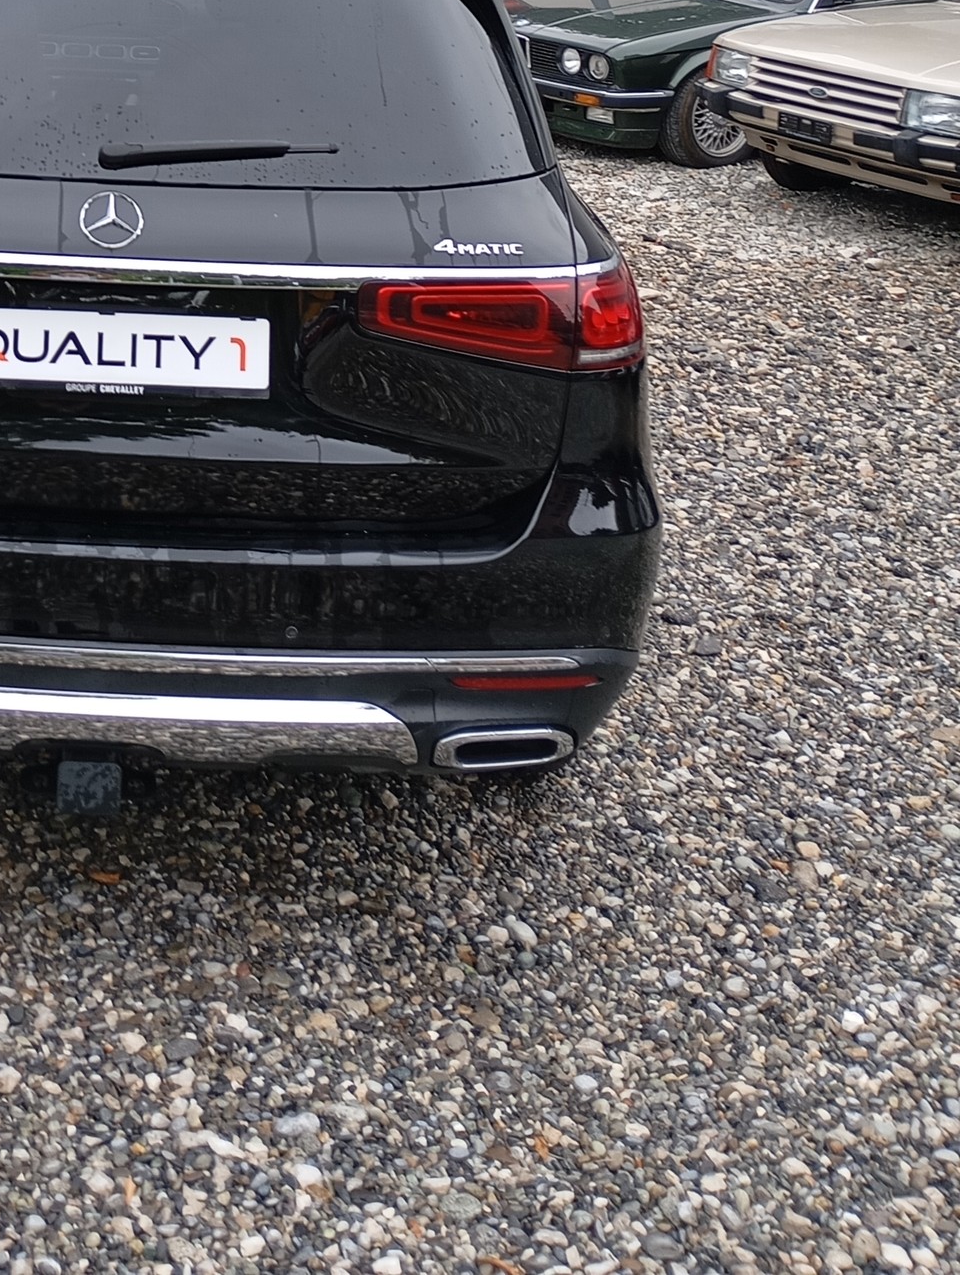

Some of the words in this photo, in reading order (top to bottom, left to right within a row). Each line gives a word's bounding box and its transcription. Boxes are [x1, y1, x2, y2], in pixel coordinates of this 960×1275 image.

[433, 238, 524, 255] 4MATIC
[230, 337, 247, 372] 1
[65, 382, 98, 394] GROUPE
[100, 384, 145, 395] CHEVALLEY
